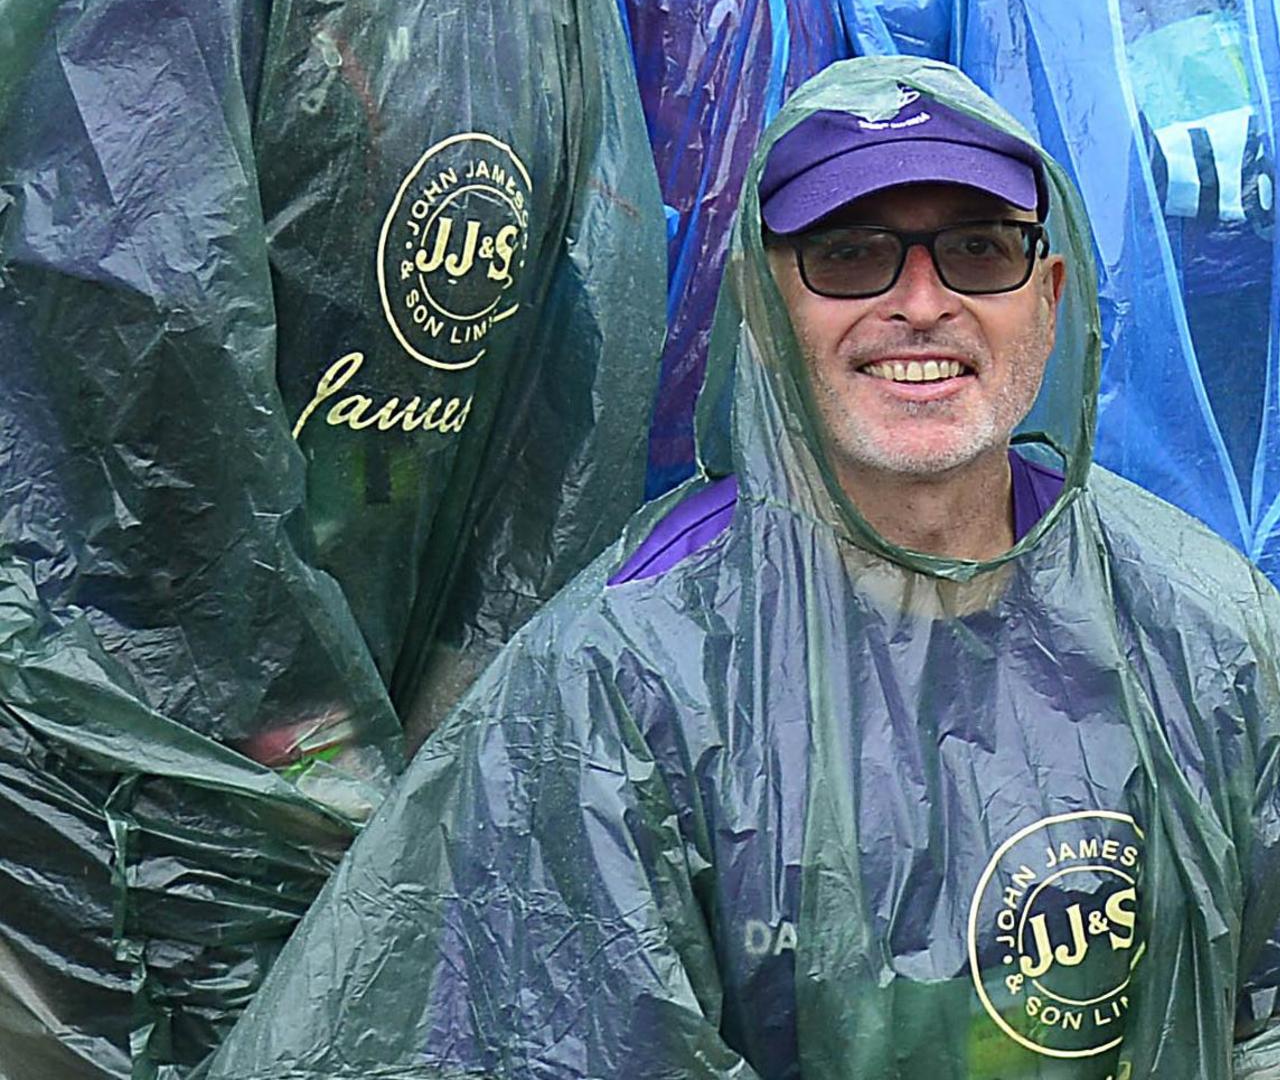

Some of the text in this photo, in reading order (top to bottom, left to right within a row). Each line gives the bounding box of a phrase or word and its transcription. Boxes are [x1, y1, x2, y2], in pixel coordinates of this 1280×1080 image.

[405, 166, 459, 236] JOHN
[415, 217, 519, 281] JJ&S
[405, 289, 444, 338] SON
[450, 312, 494, 344] LIM
[995, 838, 1141, 948] JOHN JAMES
[1020, 886, 1137, 978] JJ&S
[1026, 995, 1082, 1030] SON
